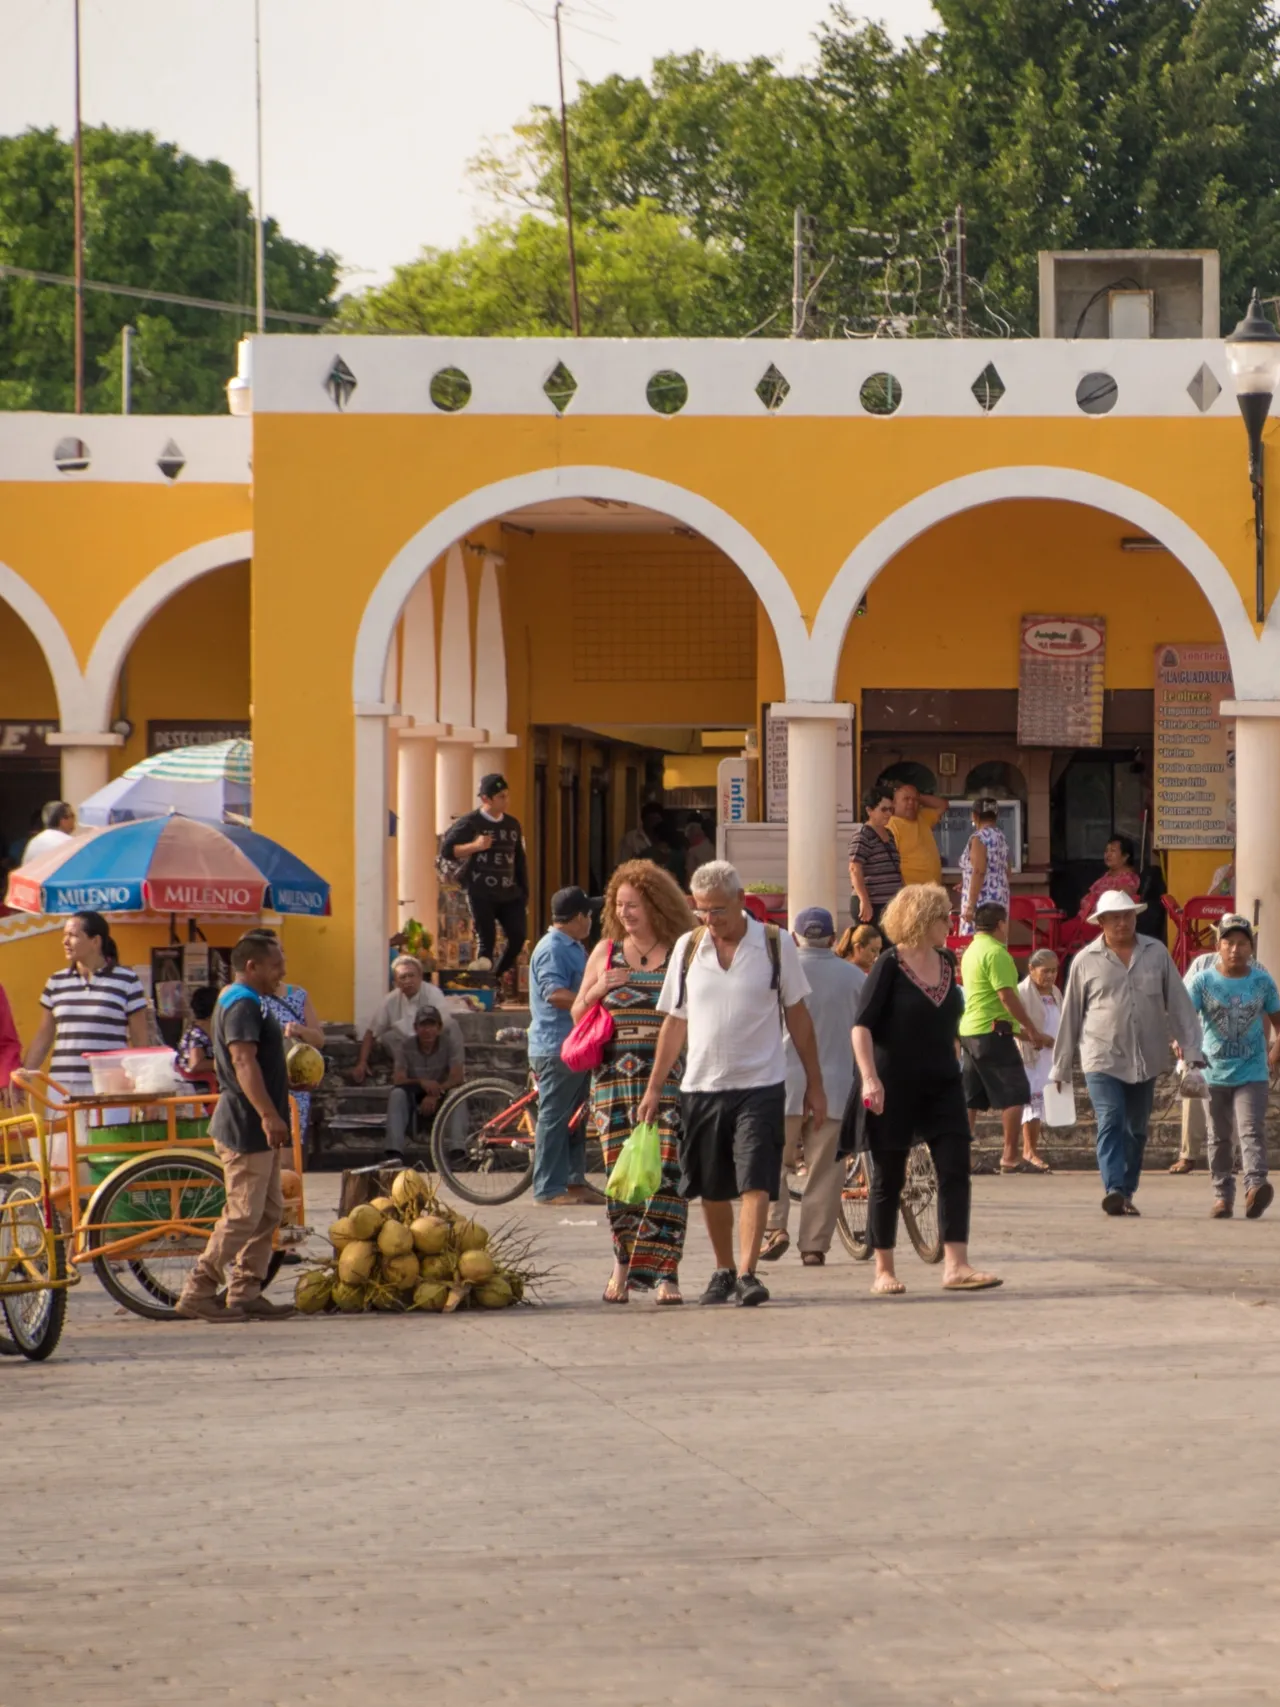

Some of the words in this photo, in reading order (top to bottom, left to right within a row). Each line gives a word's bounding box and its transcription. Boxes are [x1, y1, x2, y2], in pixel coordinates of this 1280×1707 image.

[1163, 690, 1175, 702] Le
[1163, 706, 1212, 717] Empanizado
[1186, 719, 1198, 730] de
[1199, 719, 1221, 731] pollo
[1163, 735, 1184, 745] Pollo
[1186, 734, 1210, 744] asado
[1163, 748, 1194, 758] Relleno
[1163, 763, 1185, 773] Pollo
[1186, 764, 1200, 773] con
[1202, 764, 1224, 773] arroz
[1163, 791, 1183, 802] Sopa
[1184, 791, 1195, 801] de
[1202, 819, 1225, 831] gusto
[58, 887, 130, 905] MILENIO
[165, 885, 250, 905] MILENIO
[277, 889, 323, 908] MILENIO
